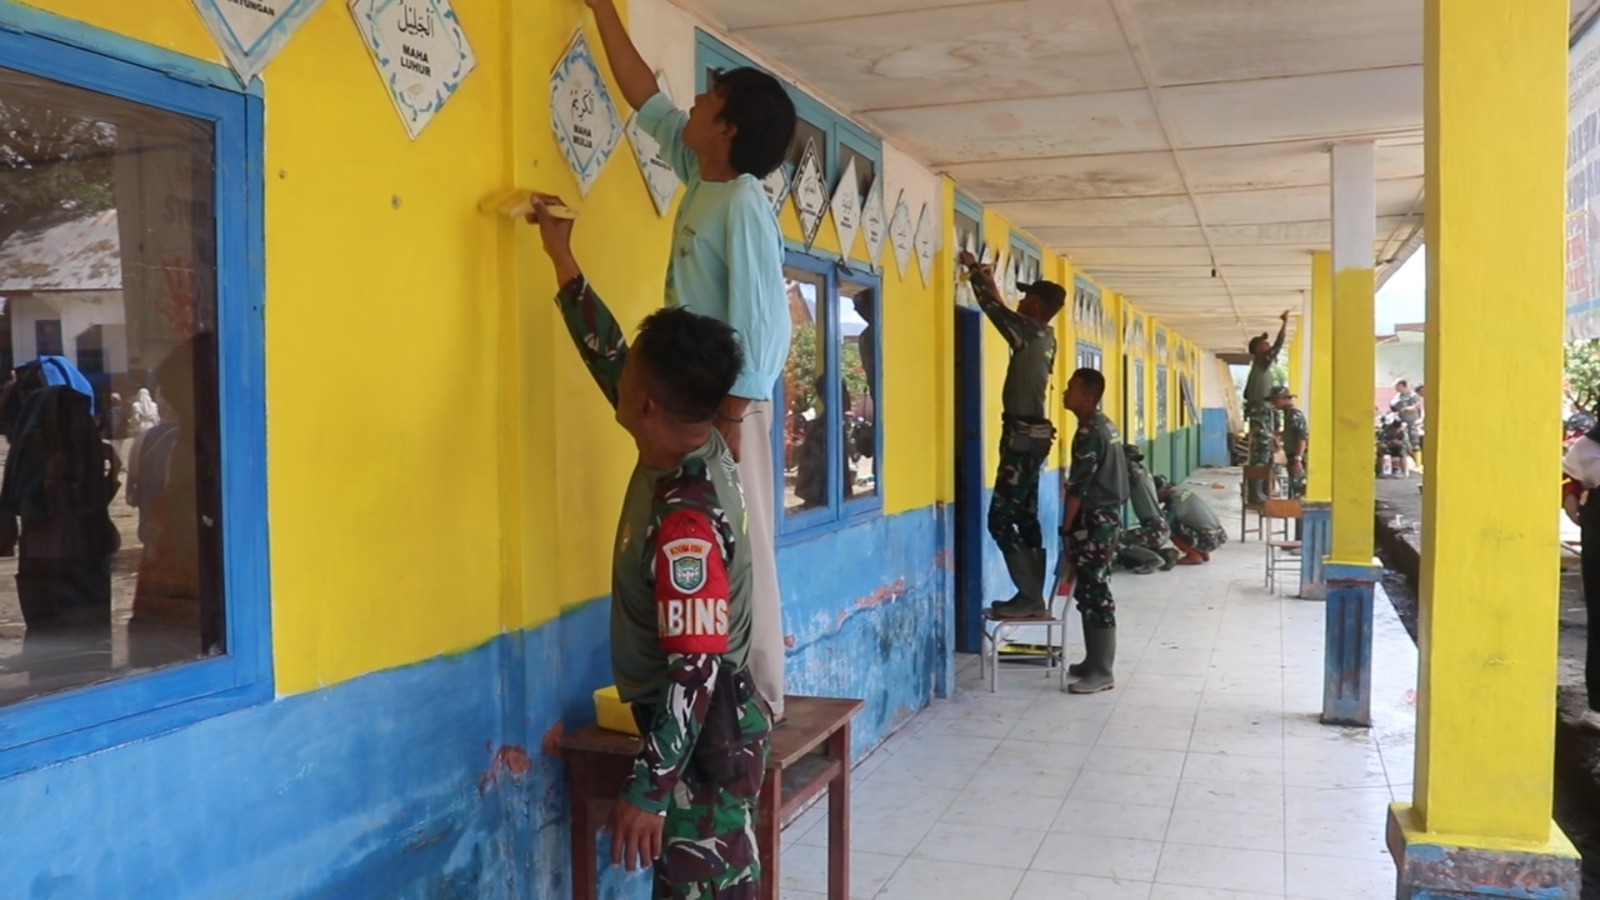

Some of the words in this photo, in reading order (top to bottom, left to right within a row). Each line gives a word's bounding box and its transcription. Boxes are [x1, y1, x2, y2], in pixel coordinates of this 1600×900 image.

[402, 44, 429, 64] MAHA
[400, 56, 431, 77] LUHUR
[573, 124, 592, 138] MAHA
